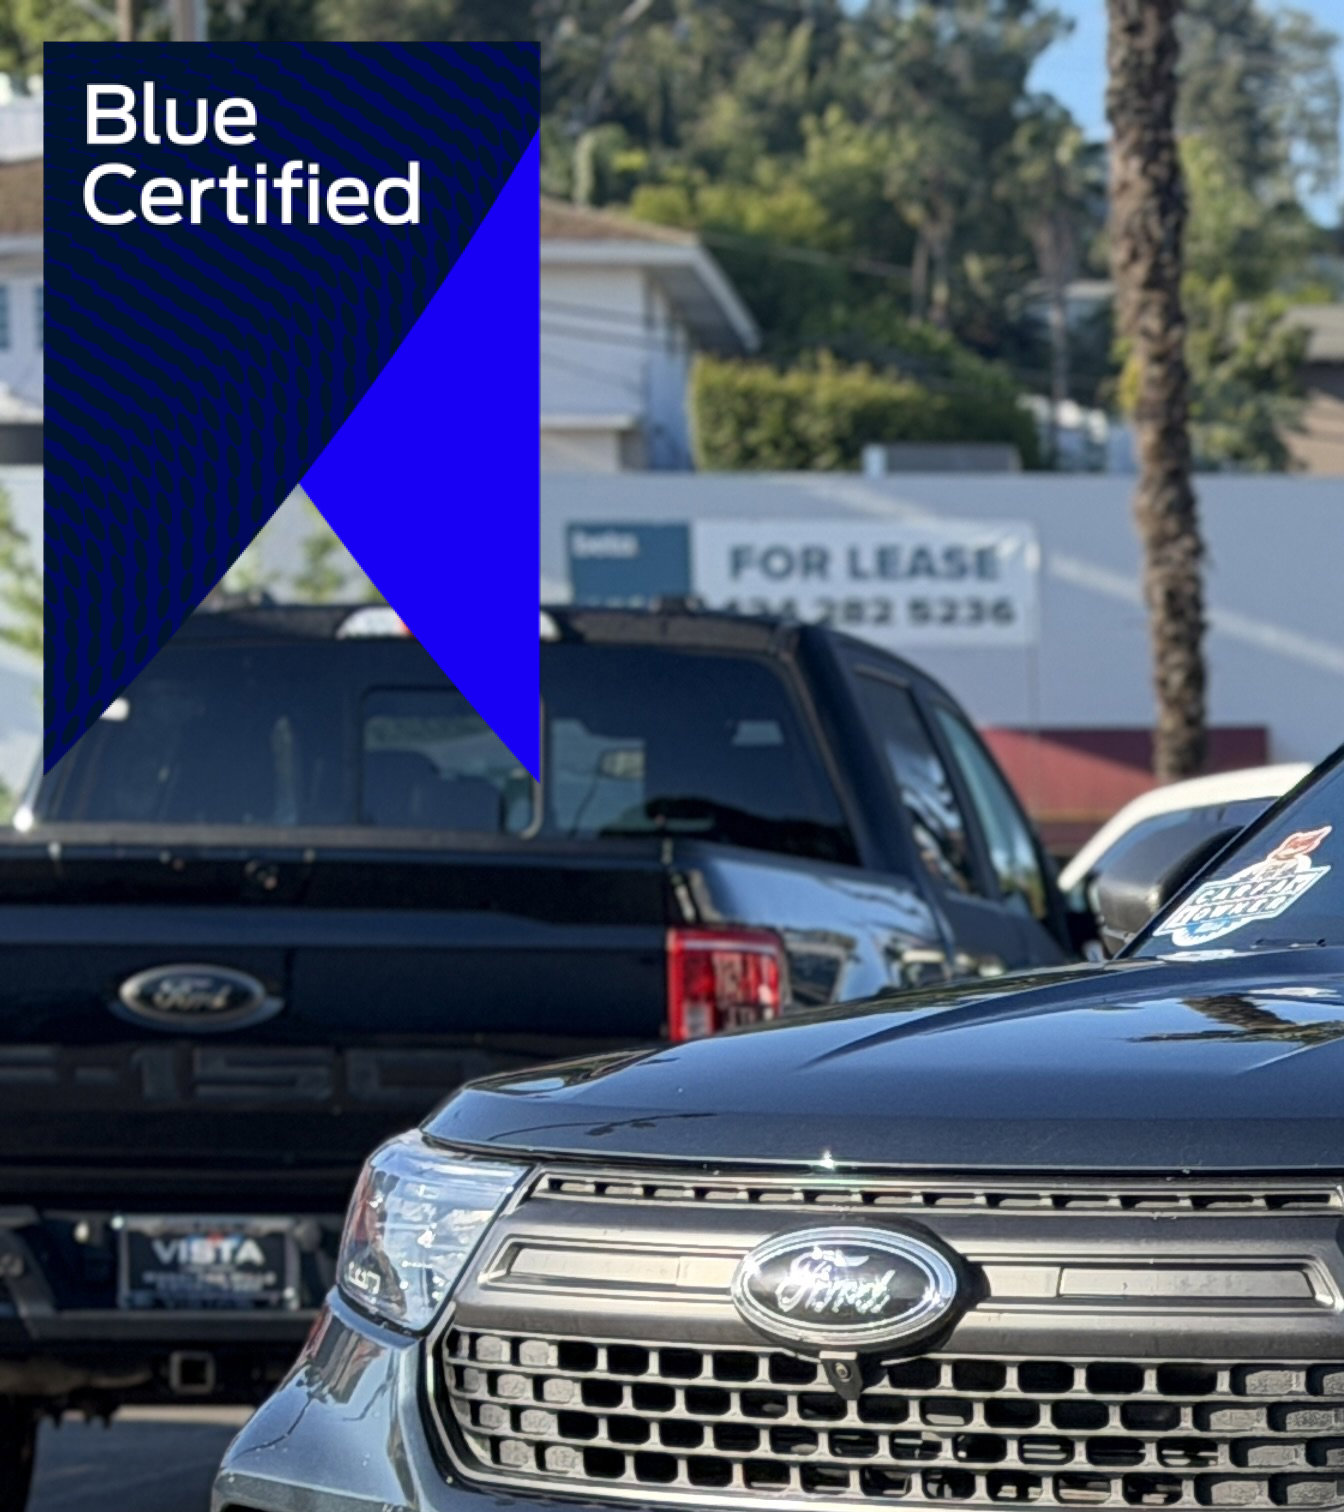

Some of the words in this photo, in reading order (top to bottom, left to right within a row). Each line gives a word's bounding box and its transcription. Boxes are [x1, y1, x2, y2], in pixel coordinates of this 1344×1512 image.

[729, 544, 831, 582] FOR
[846, 544, 1001, 582] LEASE
[907, 596, 1017, 627] 5236
[152, 976, 232, 1011] Ford
[152, 1238, 266, 1265] VISTA
[775, 1245, 896, 1314] Ford
